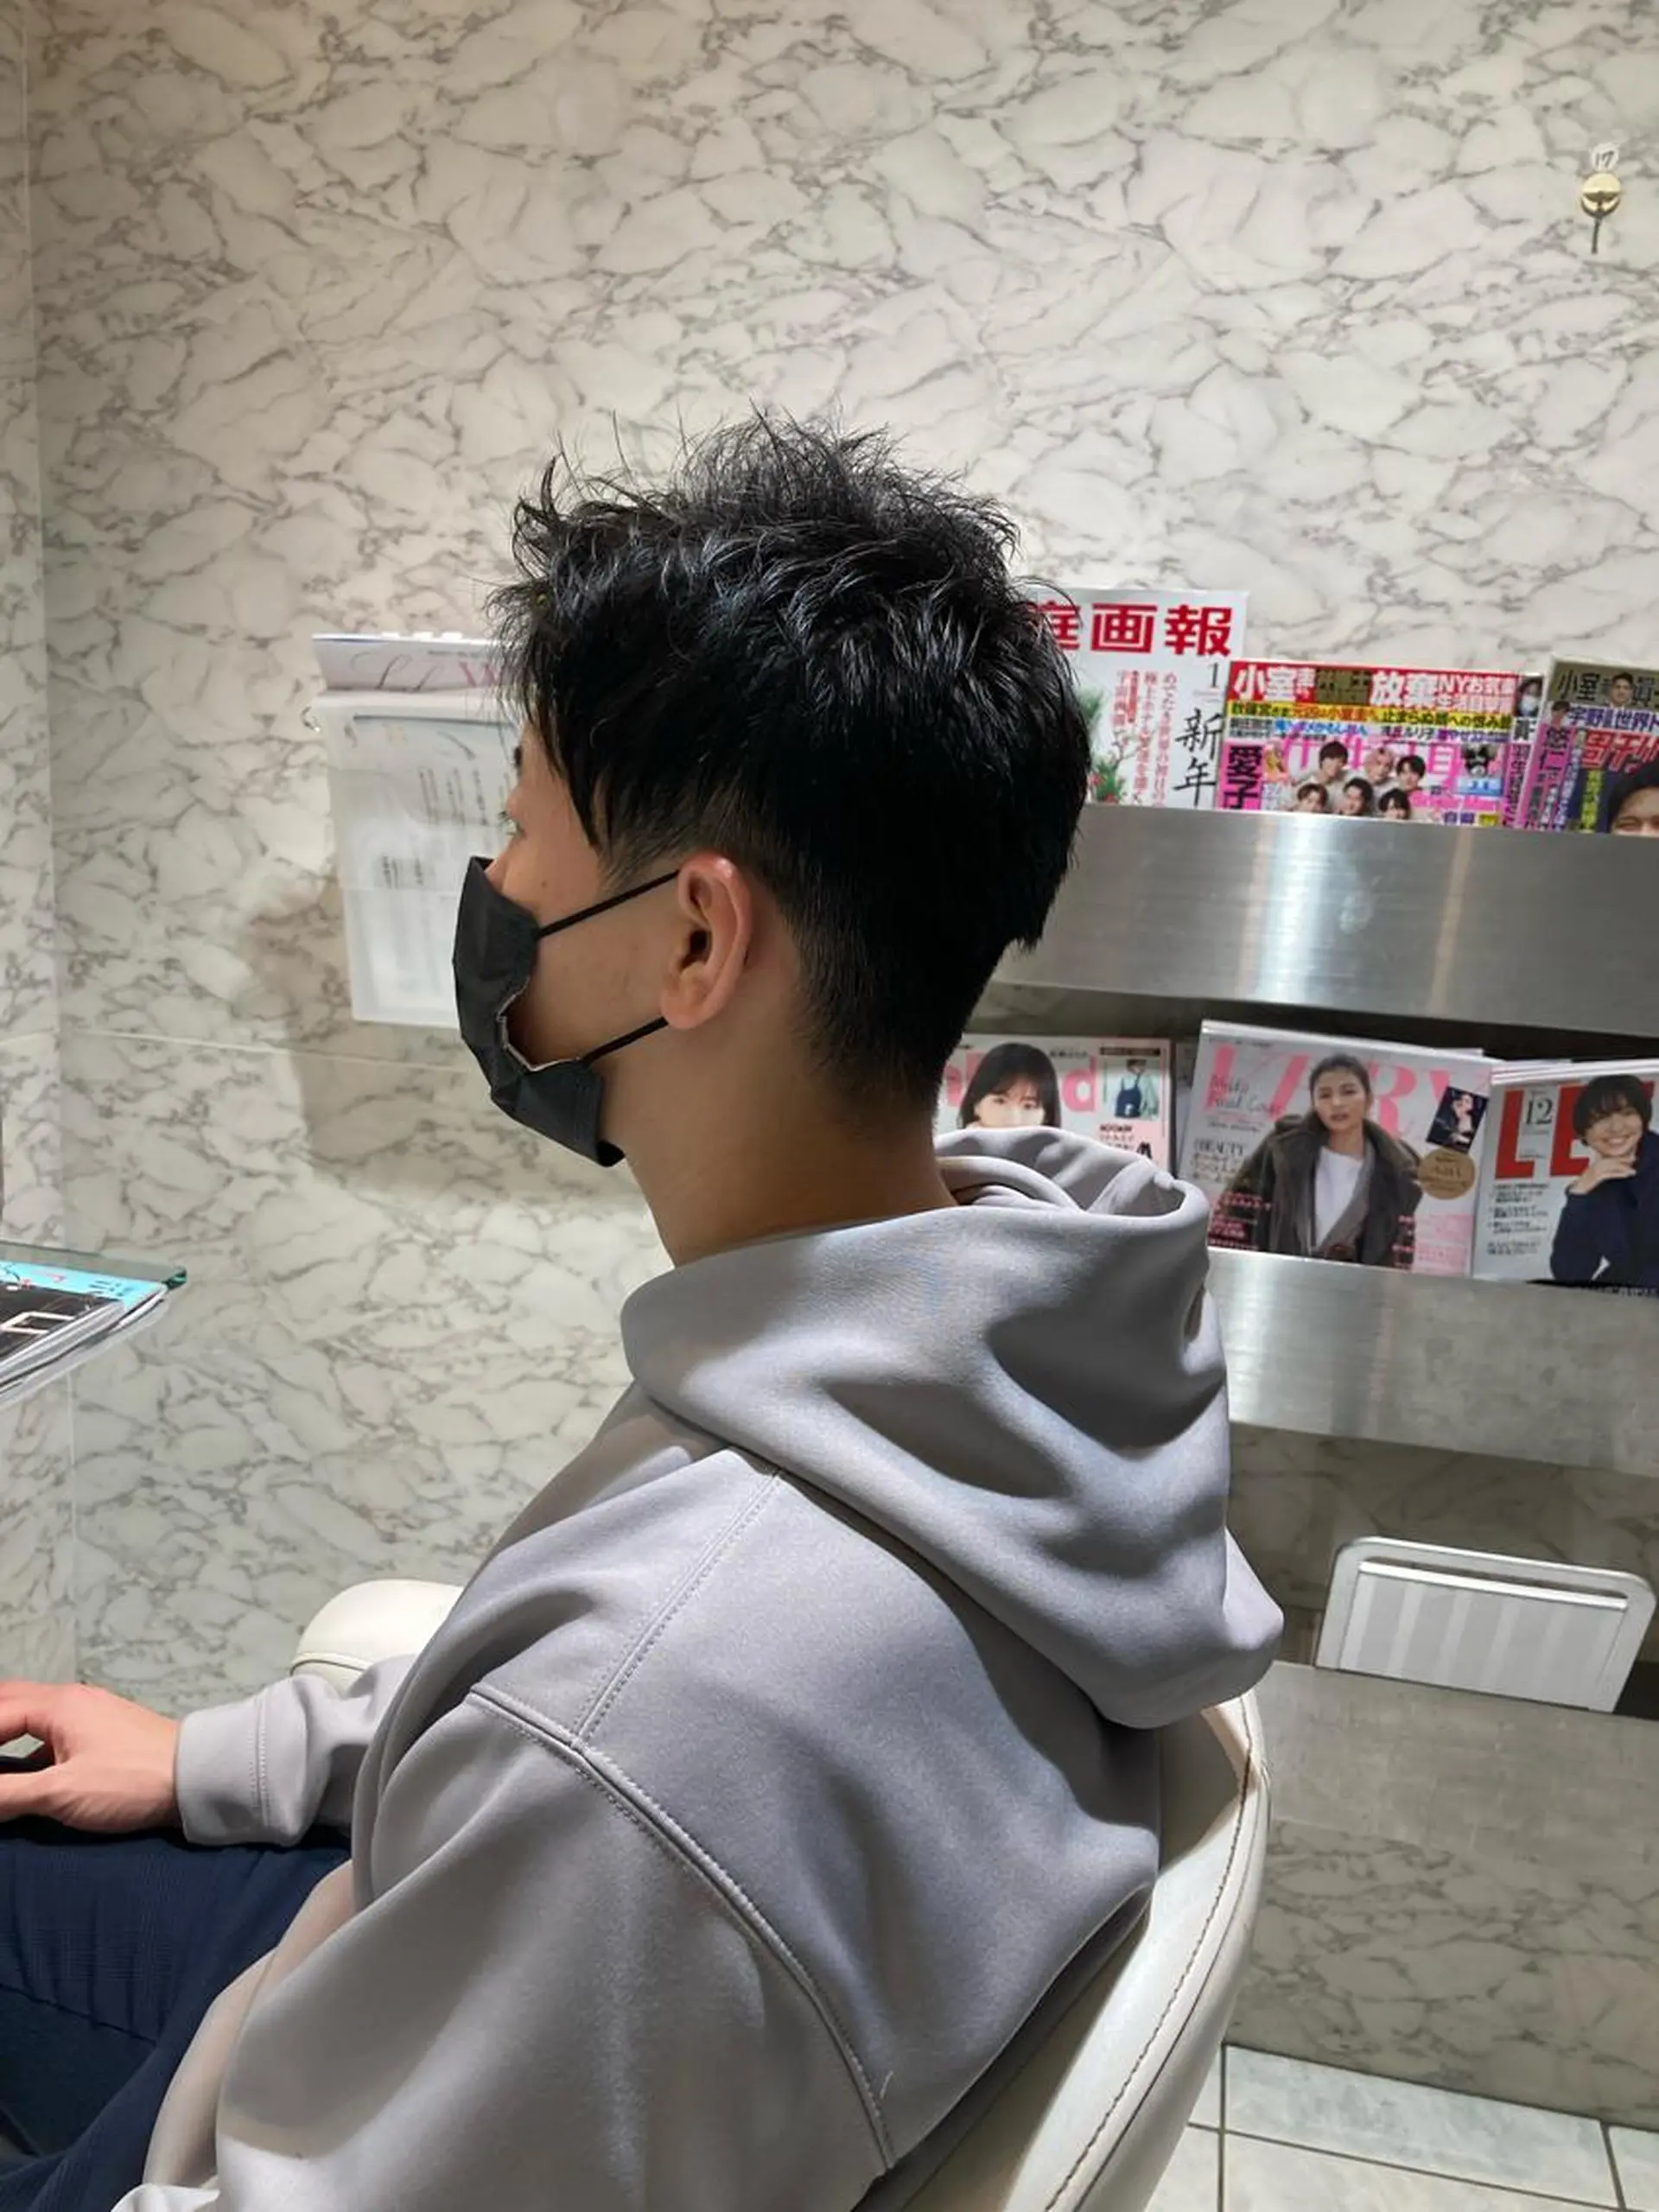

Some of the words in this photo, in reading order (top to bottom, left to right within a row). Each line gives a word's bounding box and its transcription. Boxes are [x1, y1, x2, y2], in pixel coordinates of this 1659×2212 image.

[1595, 149, 1615, 168] 17
[1173, 706, 1224, 807] 新年
[1526, 1097, 1554, 1125] 12
